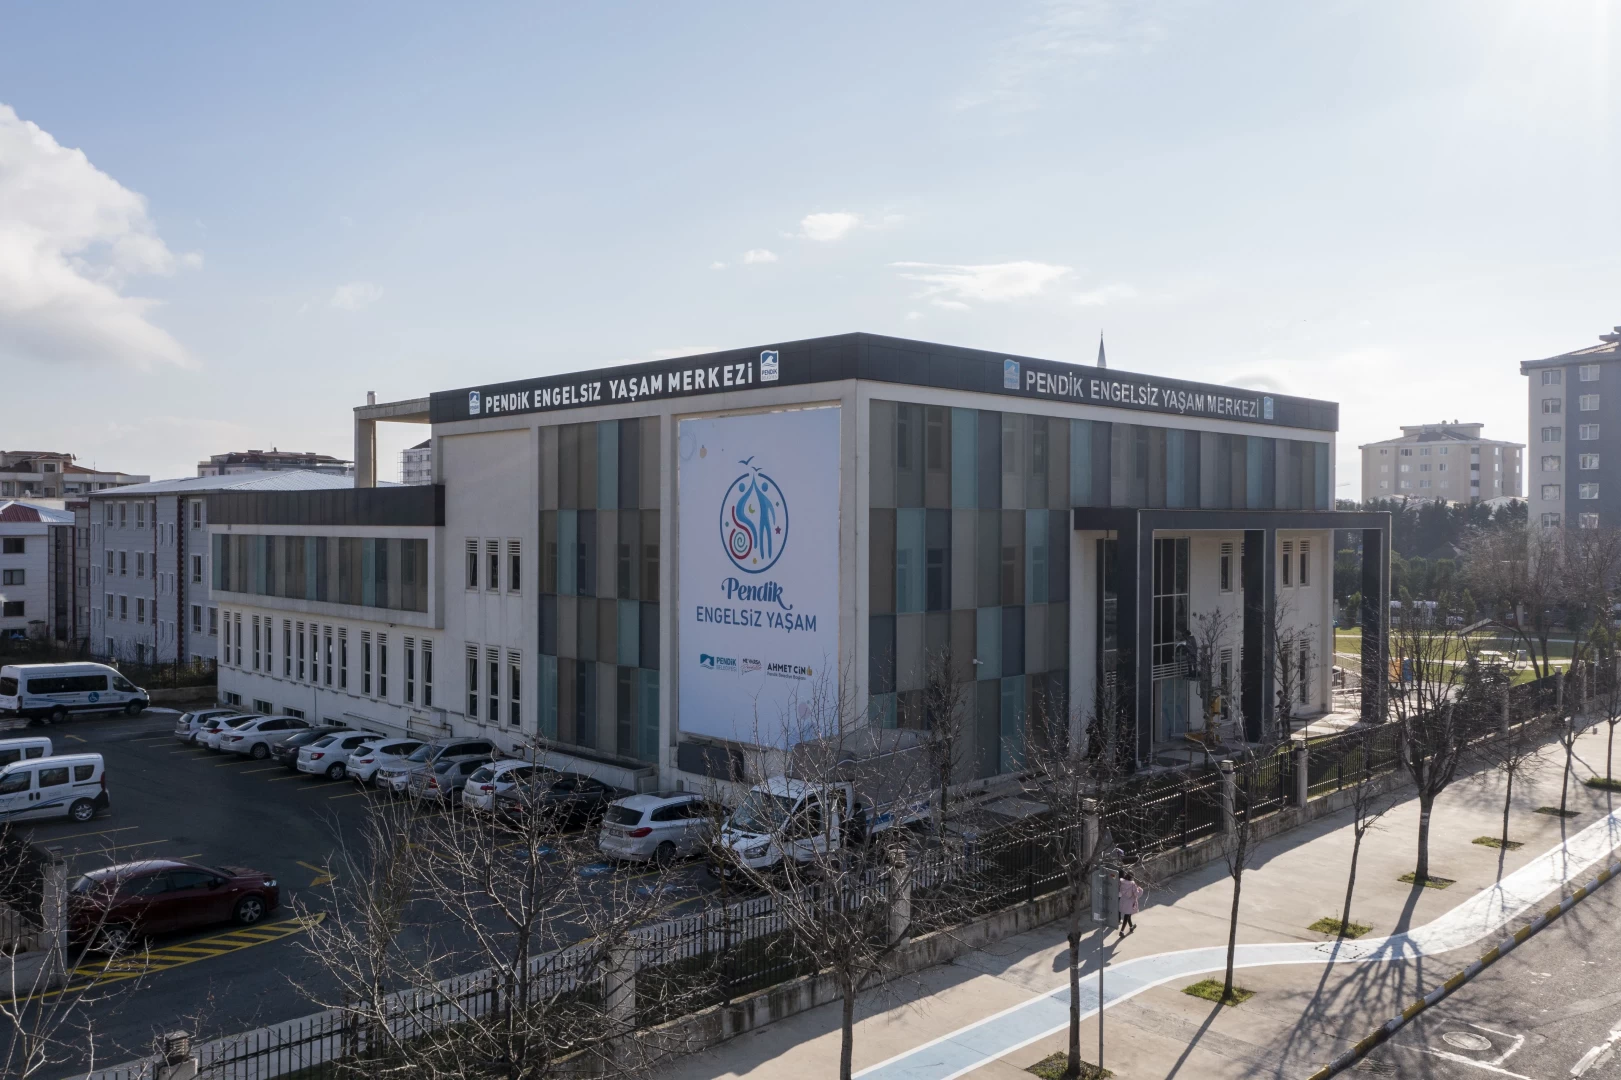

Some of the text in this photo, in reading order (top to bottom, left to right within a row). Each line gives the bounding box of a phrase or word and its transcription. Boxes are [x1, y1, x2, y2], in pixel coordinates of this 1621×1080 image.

[609, 374, 663, 401] YAŞAM
[1161, 389, 1204, 414] YAŞAM
[721, 577, 793, 611] Pendik
[766, 611, 817, 633] YAŞAM
[767, 663, 792, 673] AHMET
